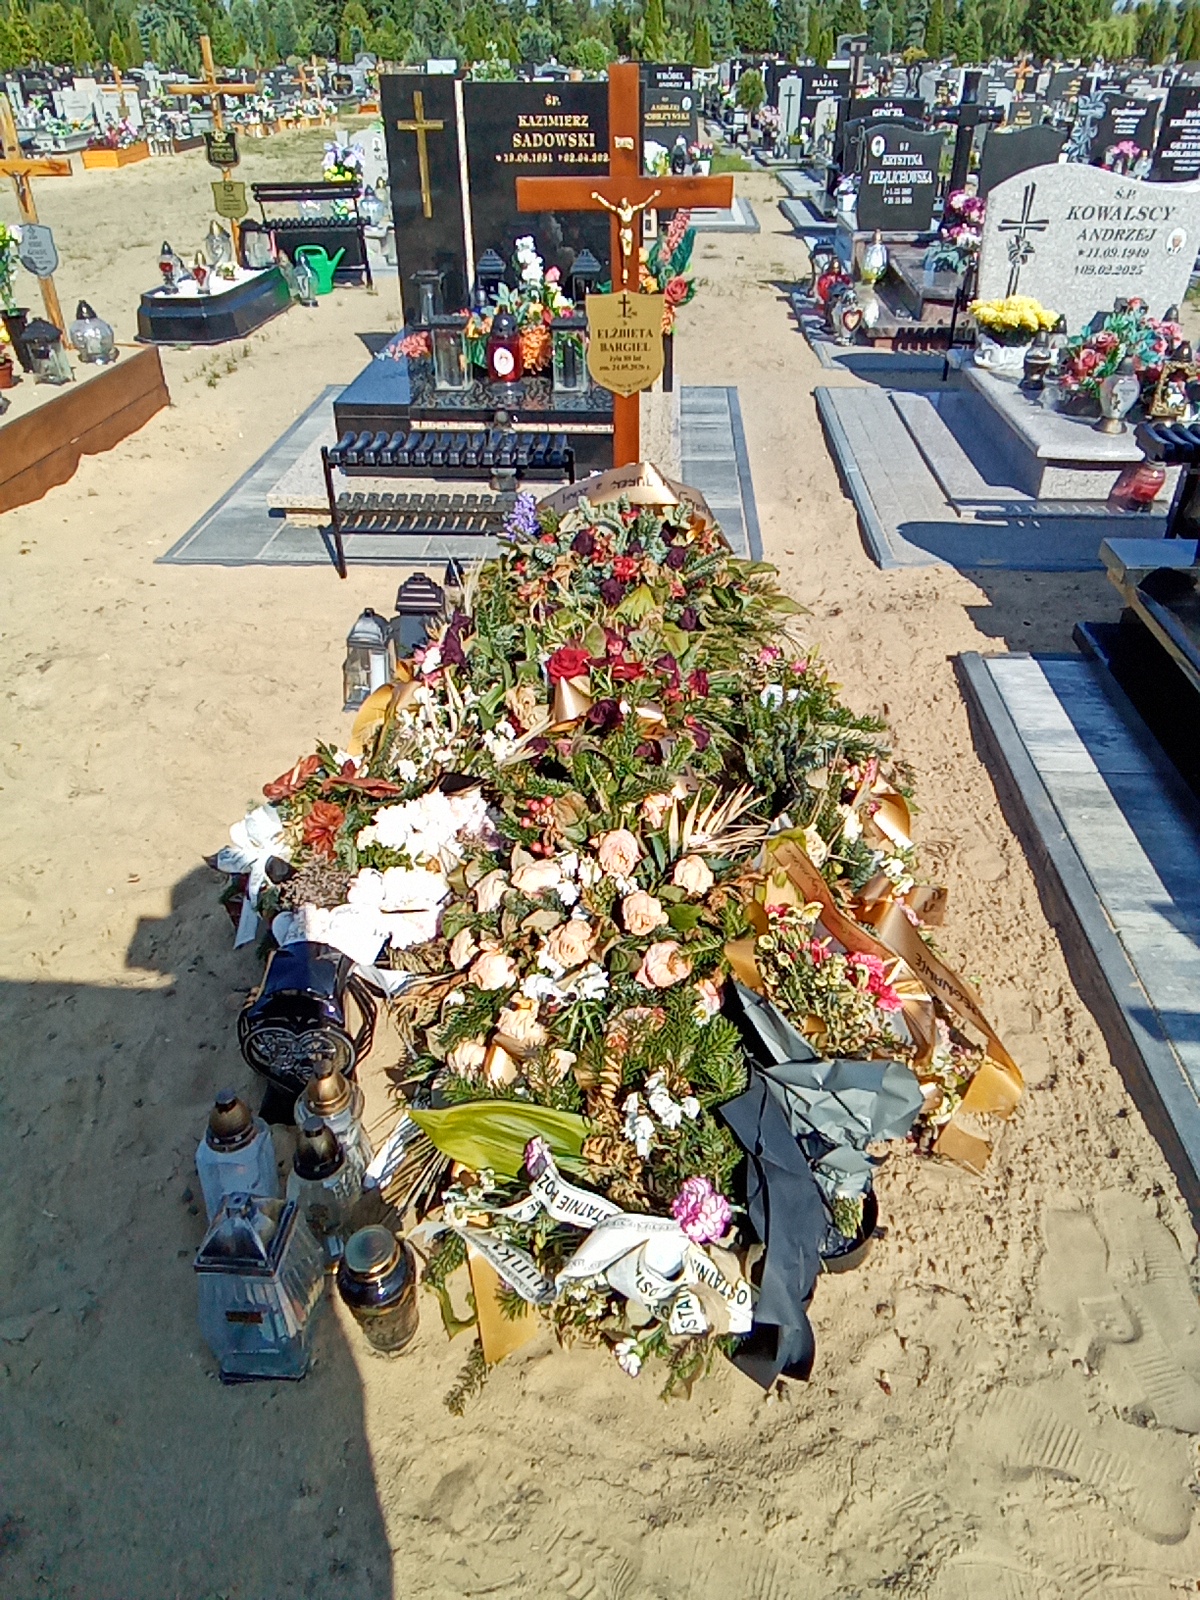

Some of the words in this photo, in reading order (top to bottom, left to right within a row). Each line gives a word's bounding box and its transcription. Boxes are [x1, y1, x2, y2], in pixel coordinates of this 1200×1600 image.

[517, 114, 589, 128] KAZIMIERZ
[512, 132, 596, 148] SADOWSKI
[1066, 206, 1176, 221] KOWALSCY
[1076, 228, 1158, 241] ANDRZEJ
[597, 327, 654, 339] ELŻBIETA
[600, 342, 652, 352] BARGIEL
